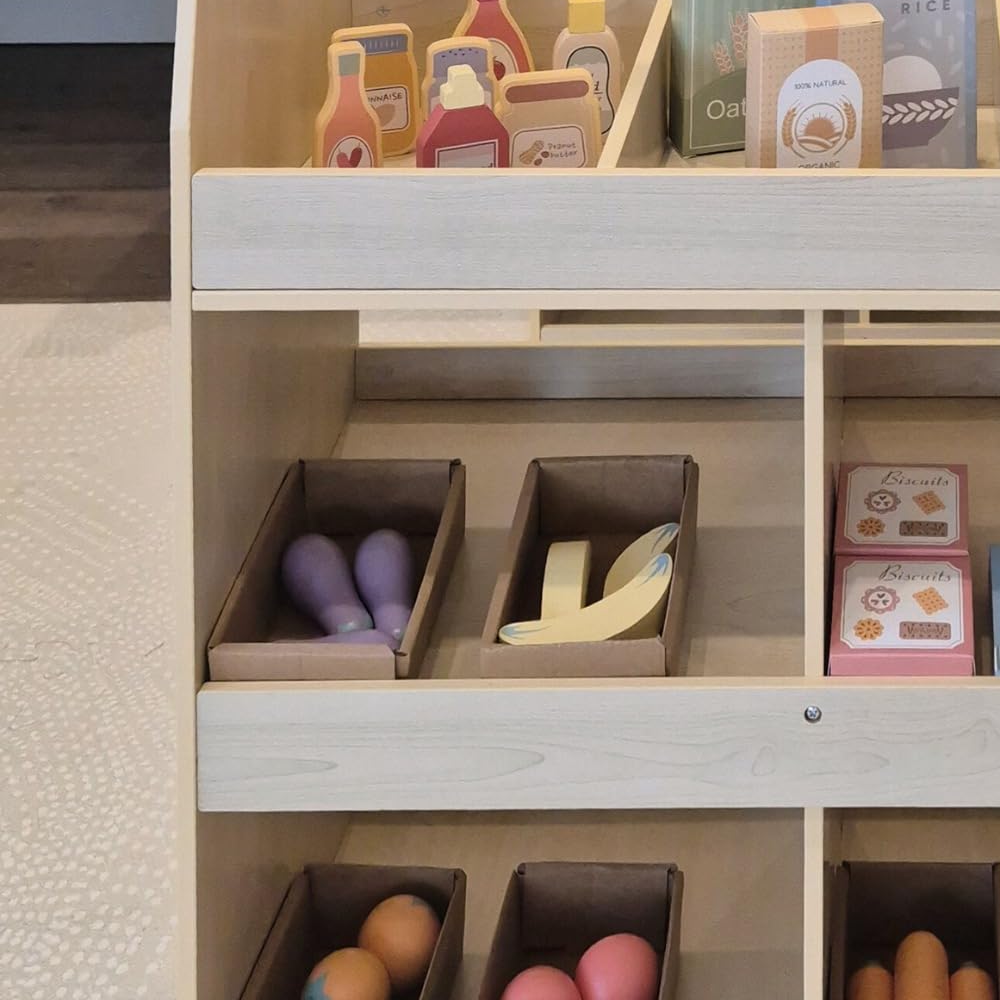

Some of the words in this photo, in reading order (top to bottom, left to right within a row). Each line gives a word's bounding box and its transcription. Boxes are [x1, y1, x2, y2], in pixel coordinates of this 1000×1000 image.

[901, 0, 951, 14] RICE
[813, 79, 847, 88] NATURAL
[881, 471, 949, 486] Biscuits
[879, 564, 951, 581] Biscuits
